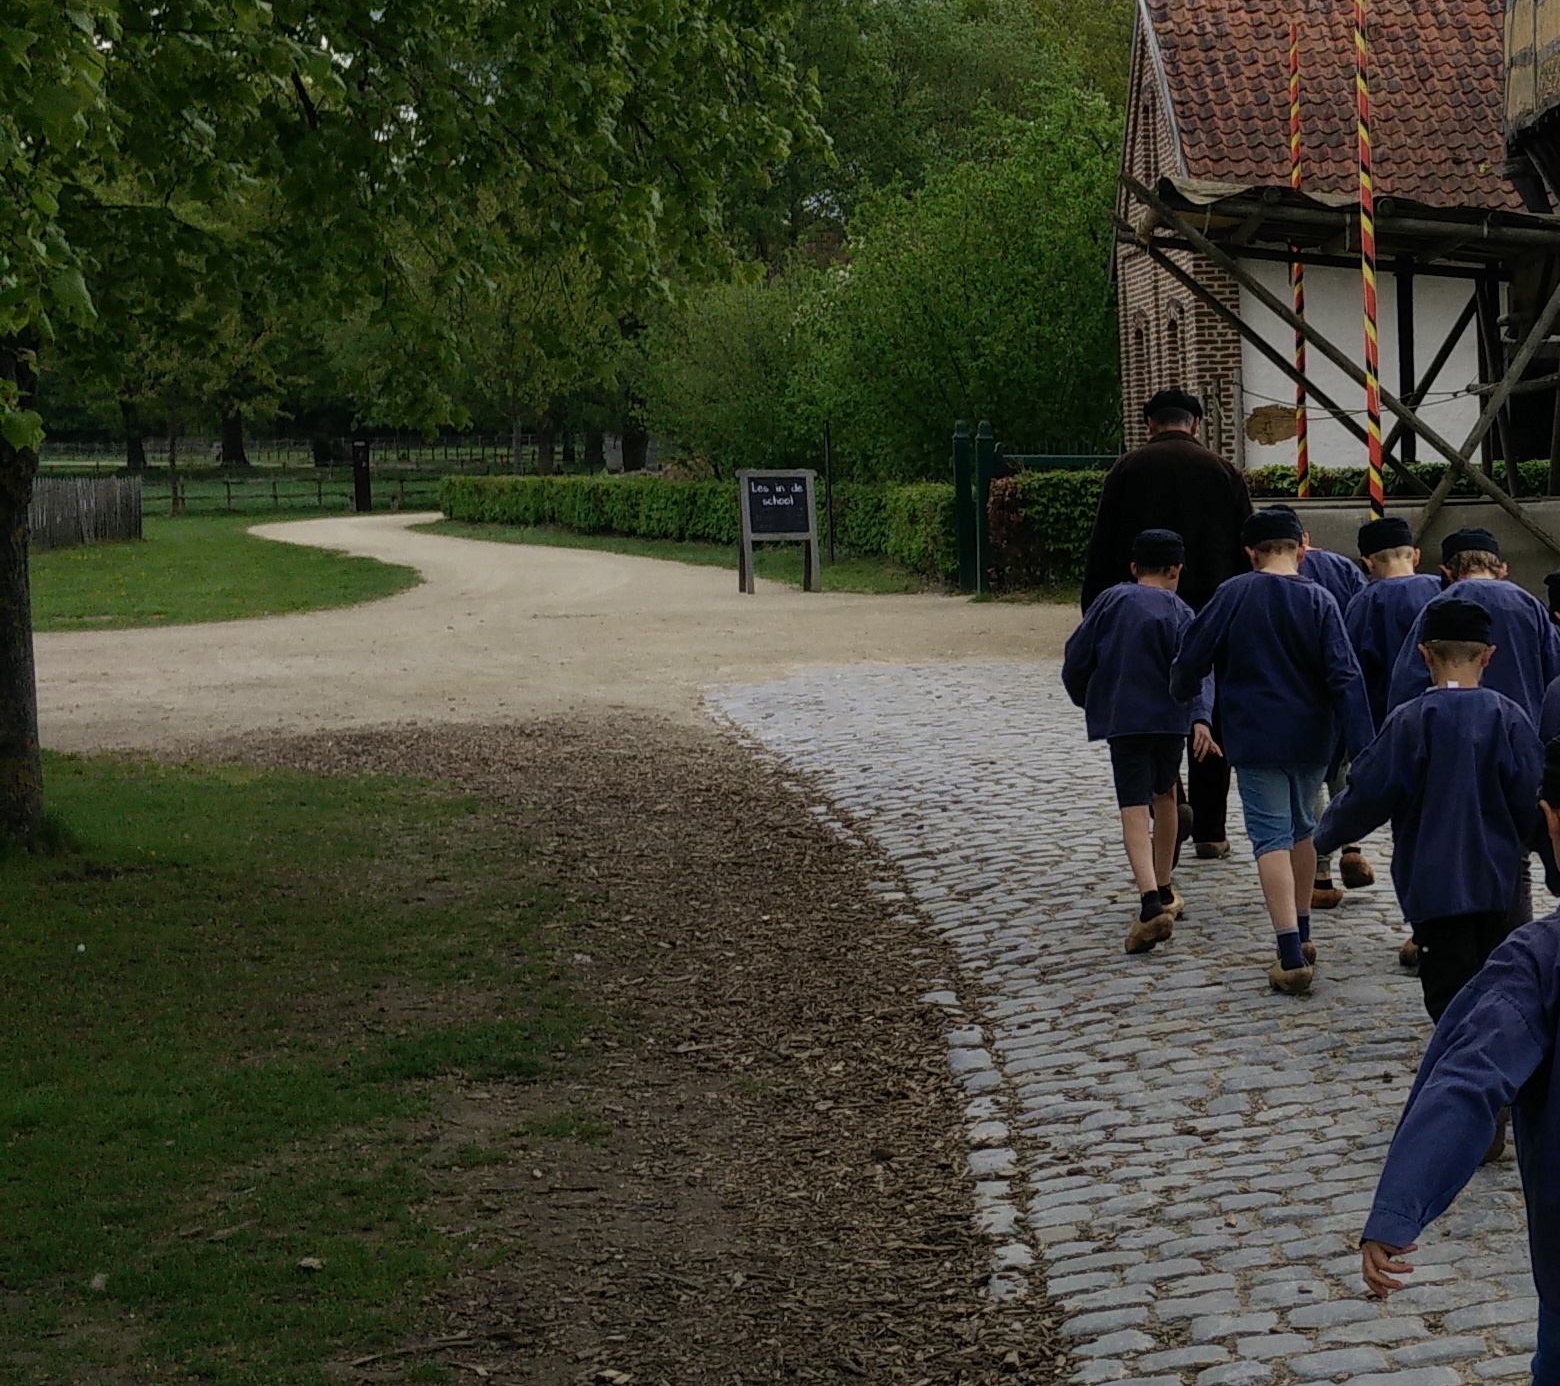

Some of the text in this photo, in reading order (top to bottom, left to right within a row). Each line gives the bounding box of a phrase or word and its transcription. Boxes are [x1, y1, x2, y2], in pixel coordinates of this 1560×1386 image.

[751, 481, 804, 493] Les in de
[762, 494, 794, 506] school
